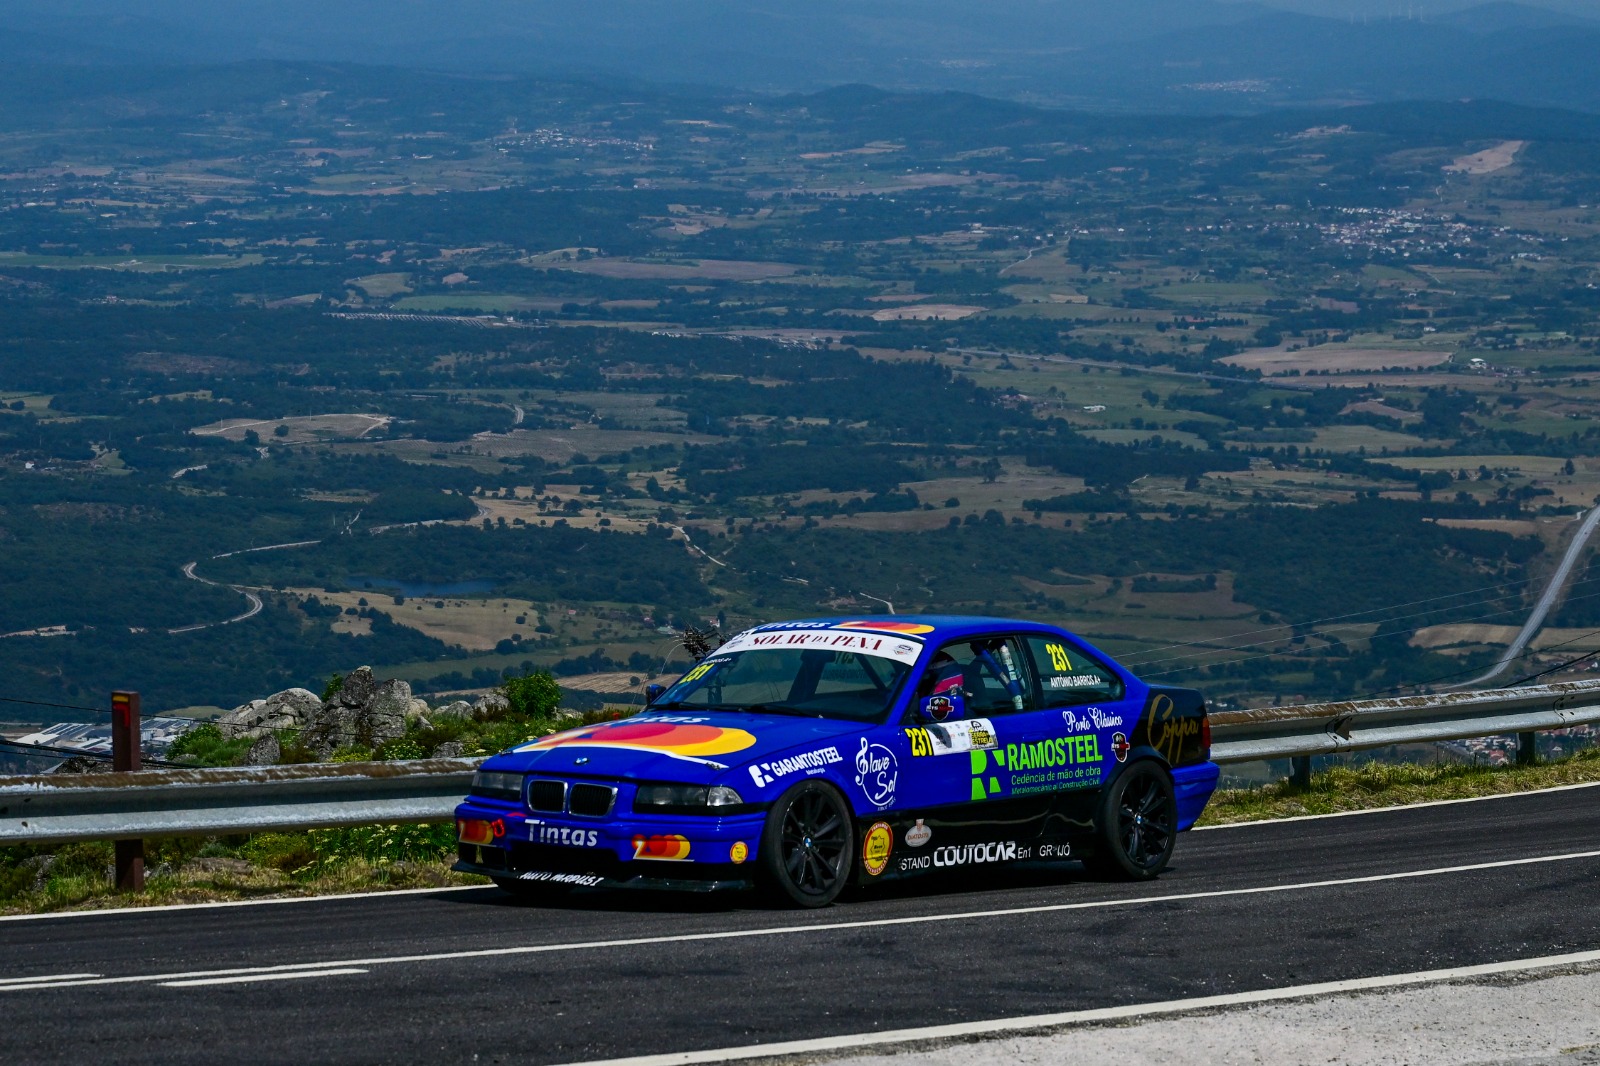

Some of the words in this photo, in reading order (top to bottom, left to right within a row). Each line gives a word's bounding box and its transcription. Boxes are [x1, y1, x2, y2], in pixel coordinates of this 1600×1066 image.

[1045, 643, 1073, 671] 231
[679, 663, 715, 684] 231
[1062, 710, 1090, 733] Porto
[904, 727, 933, 757] 231
[1007, 734, 1103, 771] RAMOSTEEL
[771, 746, 843, 777] GARANTOSTEEL
[1011, 773, 1045, 785] Cedência
[1047, 771, 1055, 781] de
[1057, 769, 1073, 780] mão
[1074, 767, 1084, 778] de
[1086, 766, 1101, 776] obra
[874, 771, 898, 800] Sol
[525, 819, 598, 847] Tintas
[900, 856, 931, 871] STAND
[933, 841, 1016, 867] COUTOCAR
